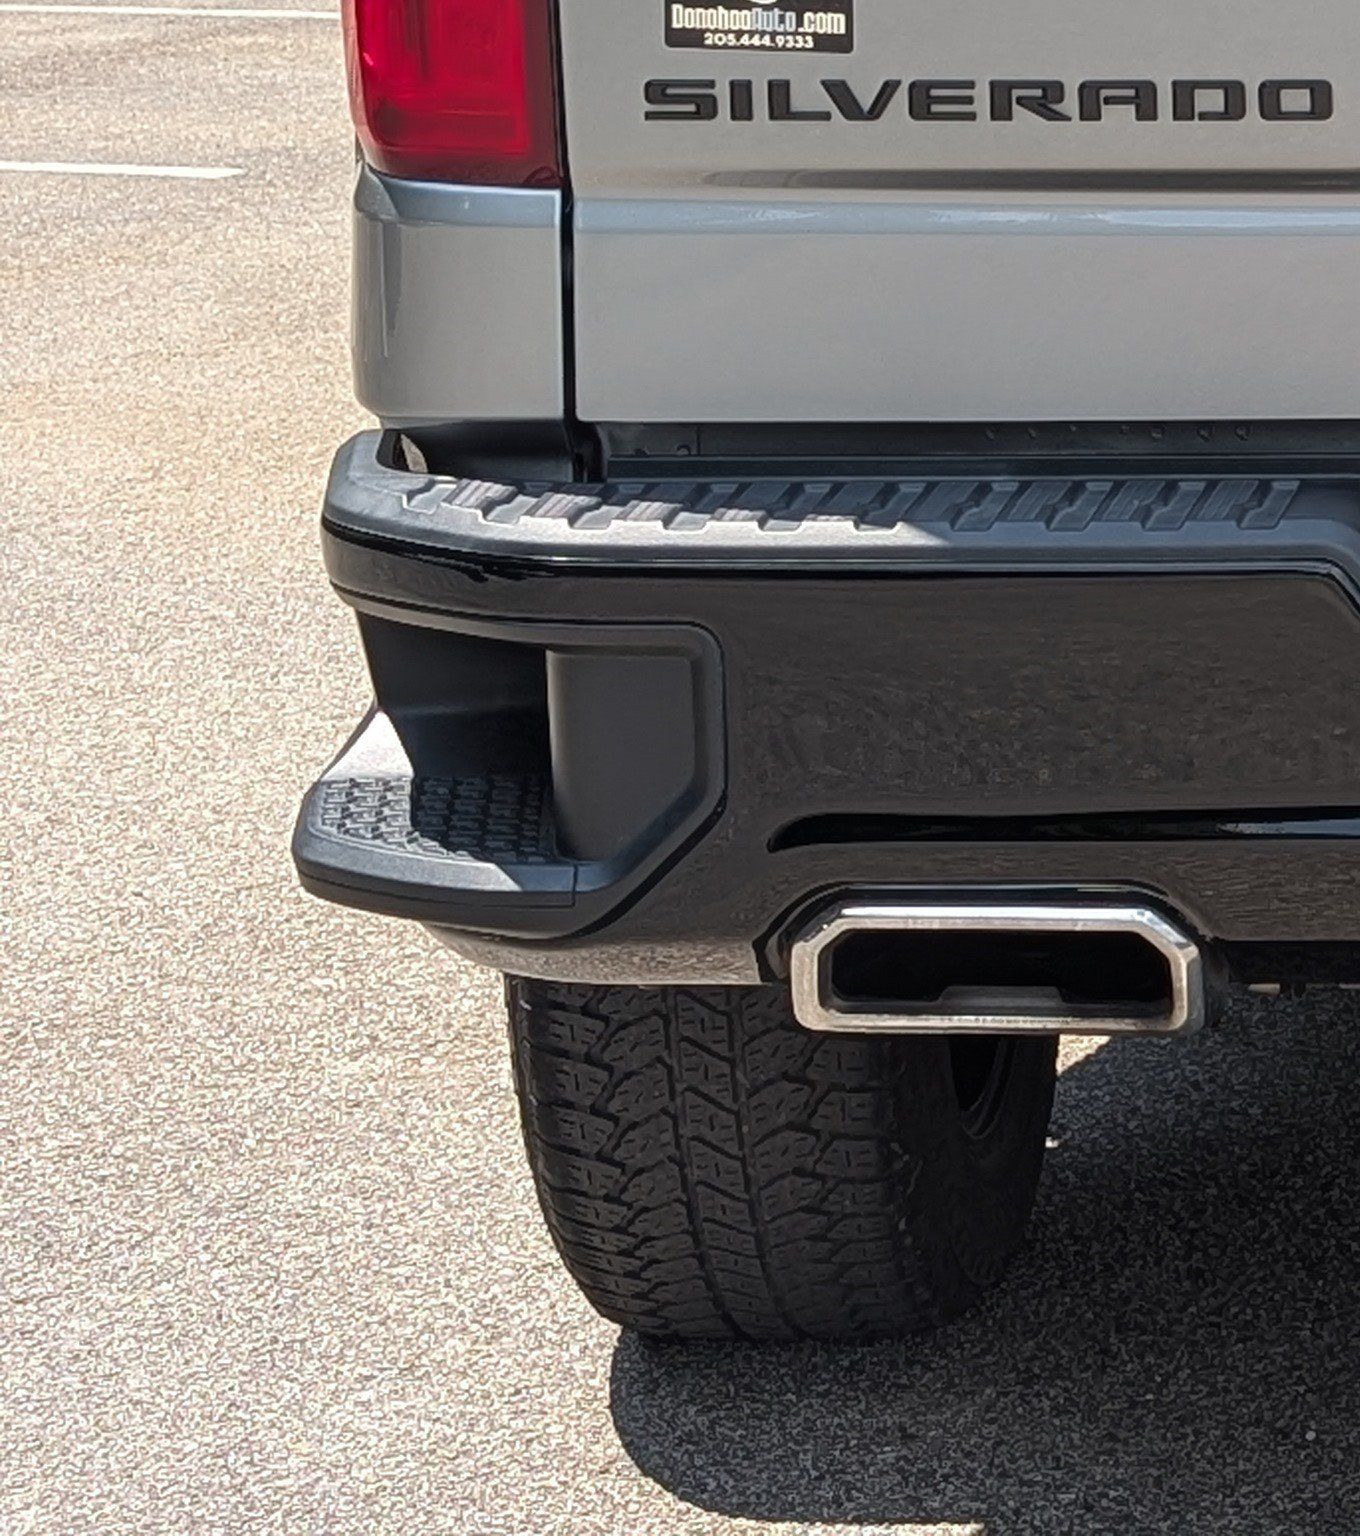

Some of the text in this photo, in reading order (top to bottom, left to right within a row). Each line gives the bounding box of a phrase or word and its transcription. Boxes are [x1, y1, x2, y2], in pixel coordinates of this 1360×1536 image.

[670, 3, 847, 35] DonohooAuto.com
[703, 31, 815, 49] 205.444.9333
[643, 78, 1333, 122] SILVERADO
